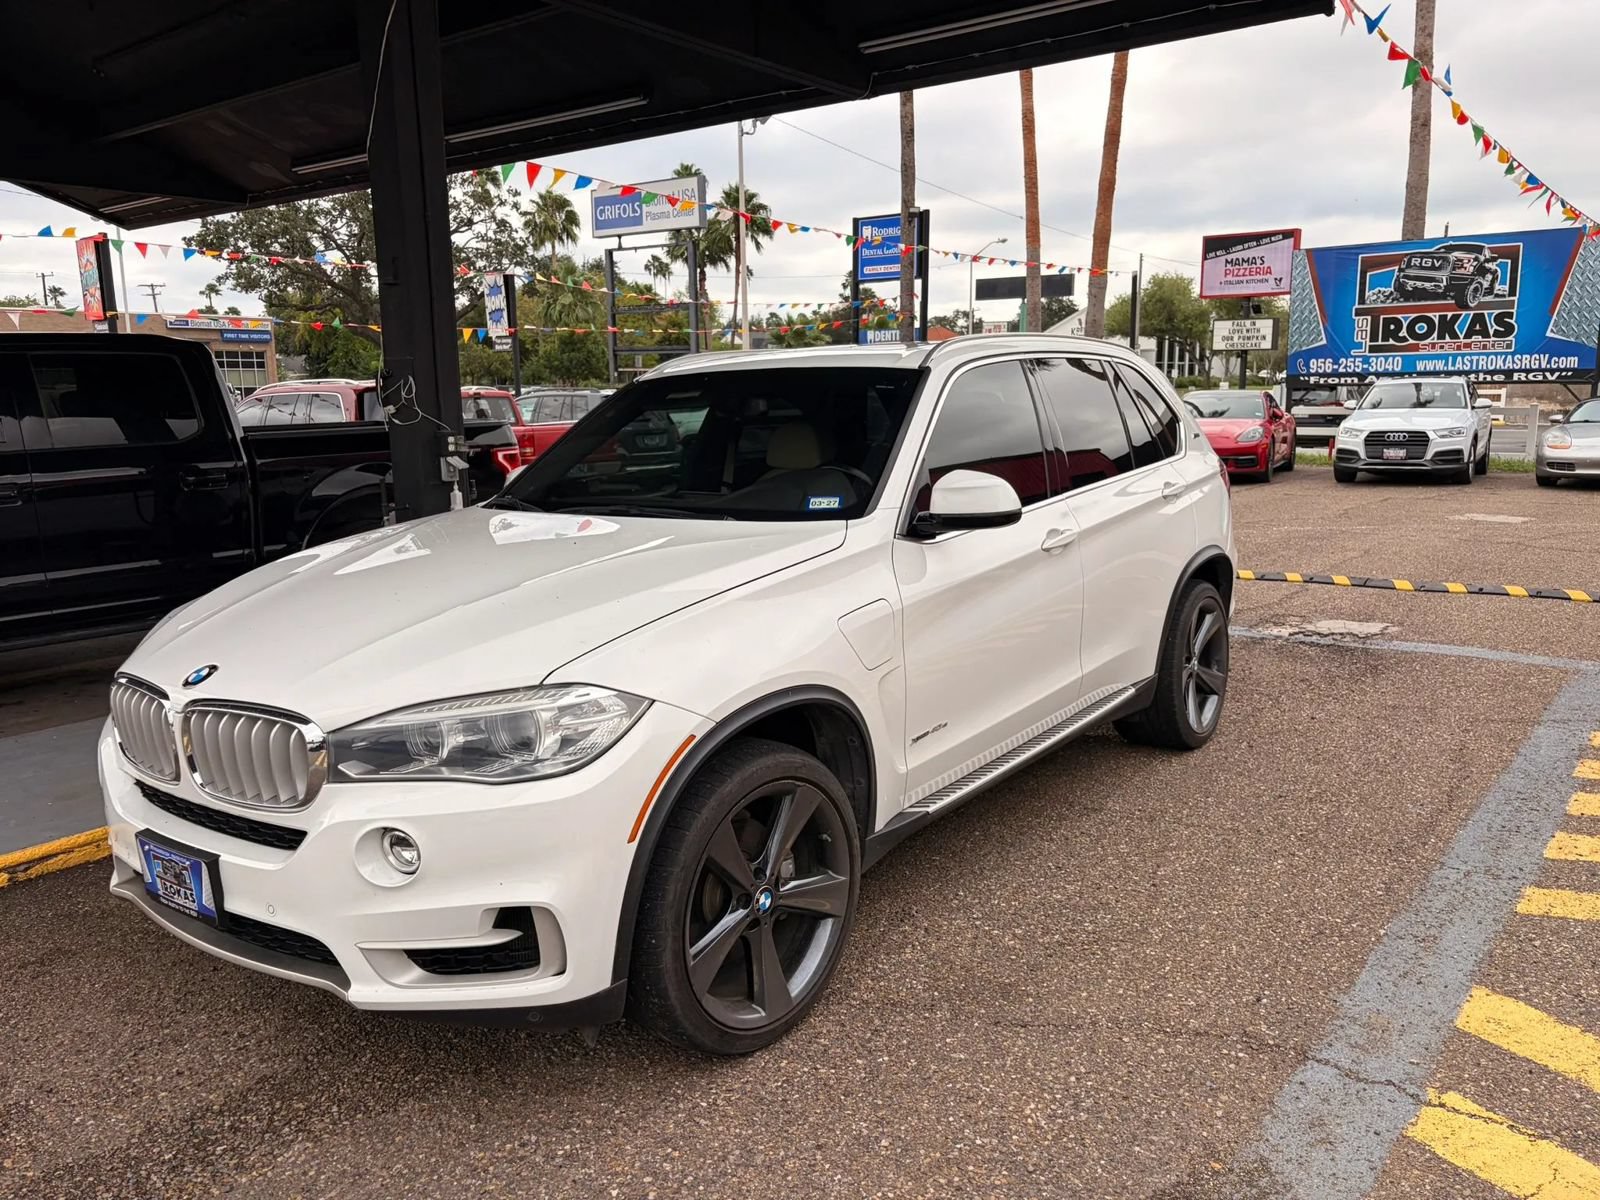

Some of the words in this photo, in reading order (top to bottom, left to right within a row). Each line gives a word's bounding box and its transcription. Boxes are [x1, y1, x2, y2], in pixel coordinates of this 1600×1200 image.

[677, 187, 697, 202] USA
[596, 201, 642, 220] GRIFOLS
[645, 210, 671, 221] Plasma
[872, 226, 901, 237] RODRIG
[862, 248, 884, 256] DENTAL
[883, 246, 901, 255] GROU
[1224, 256, 1265, 268] MAMA'S
[1410, 257, 1443, 268] RGV
[1224, 266, 1273, 278] PIZZERIA
[1369, 310, 1518, 344] TROKAS
[875, 330, 900, 341] DENTI
[1309, 356, 1402, 373] 956-255-3040
[1416, 354, 1578, 371] www.LASTROKASRGV.com
[1468, 373, 1506, 382] the
